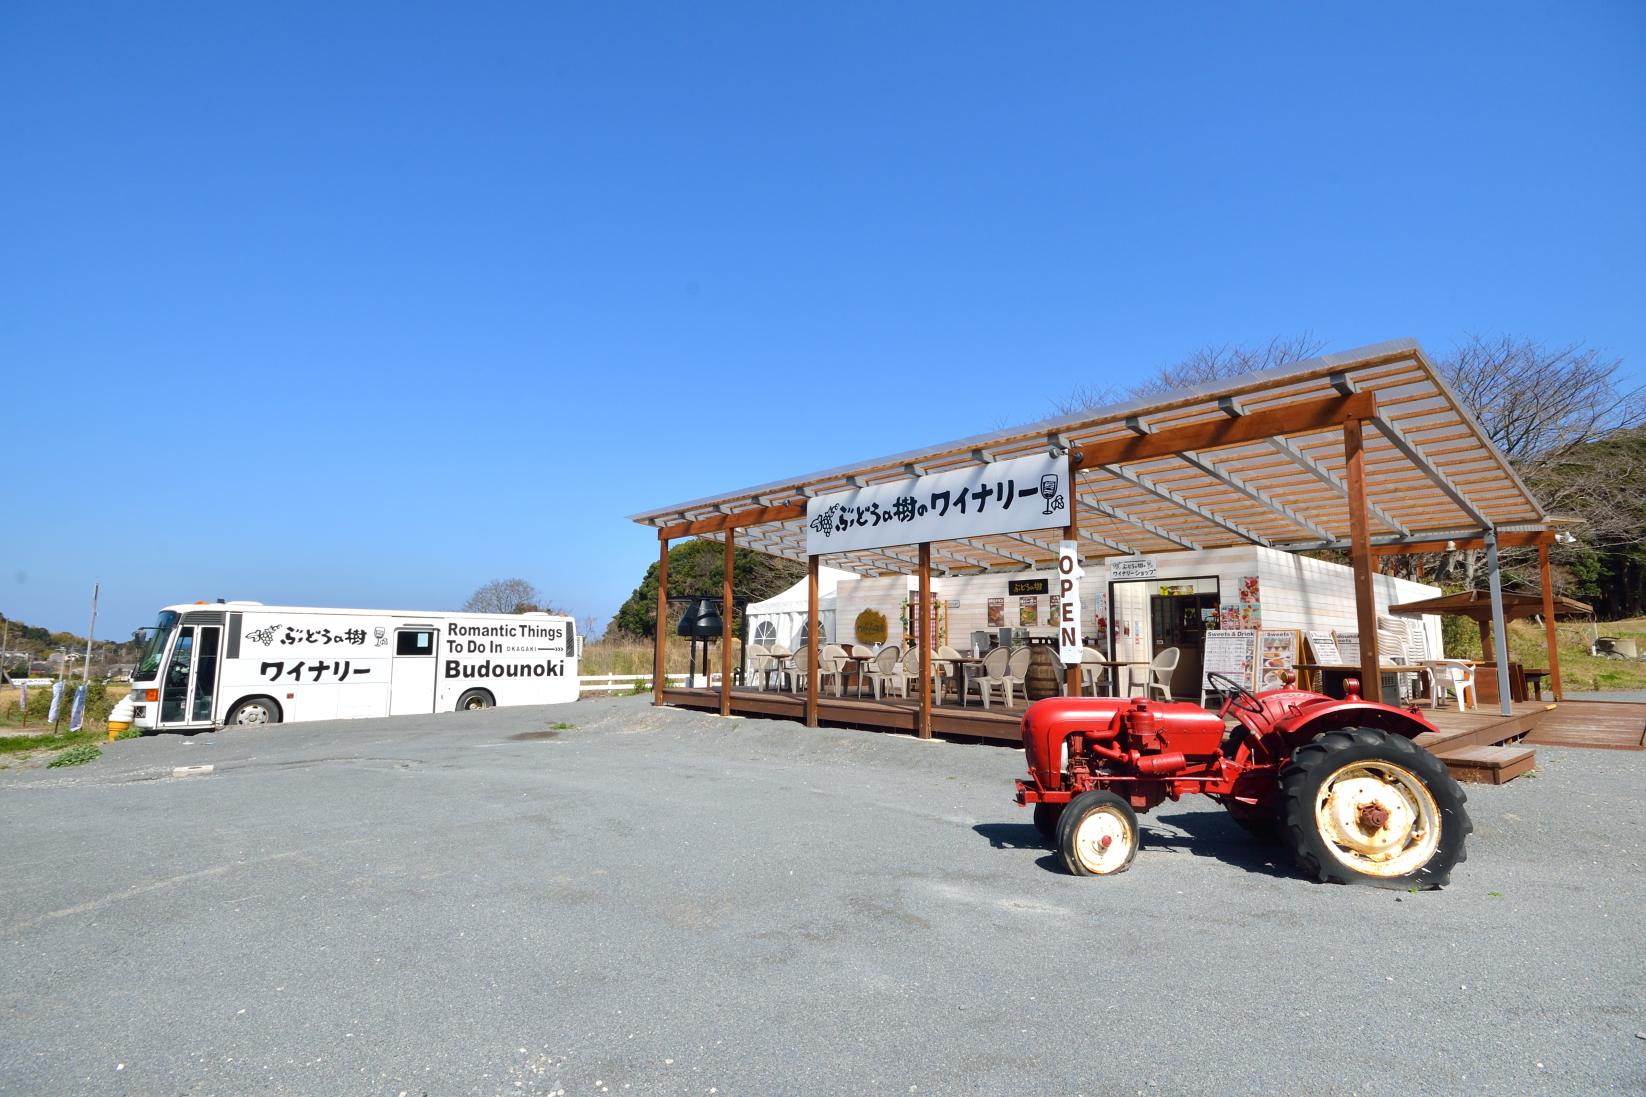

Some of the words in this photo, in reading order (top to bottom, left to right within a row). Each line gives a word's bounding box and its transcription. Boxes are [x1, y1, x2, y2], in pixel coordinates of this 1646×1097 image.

[1059, 555, 1076, 647] OPEN
[280, 626, 367, 645] ぶどうの樹
[448, 622, 517, 637] Romantic
[519, 624, 562, 641] Things
[447, 640, 463, 653] To
[467, 640, 486, 653] Do
[490, 640, 503, 653] In
[260, 660, 371, 682] ワイナリー
[445, 660, 564, 678] Budounoki
